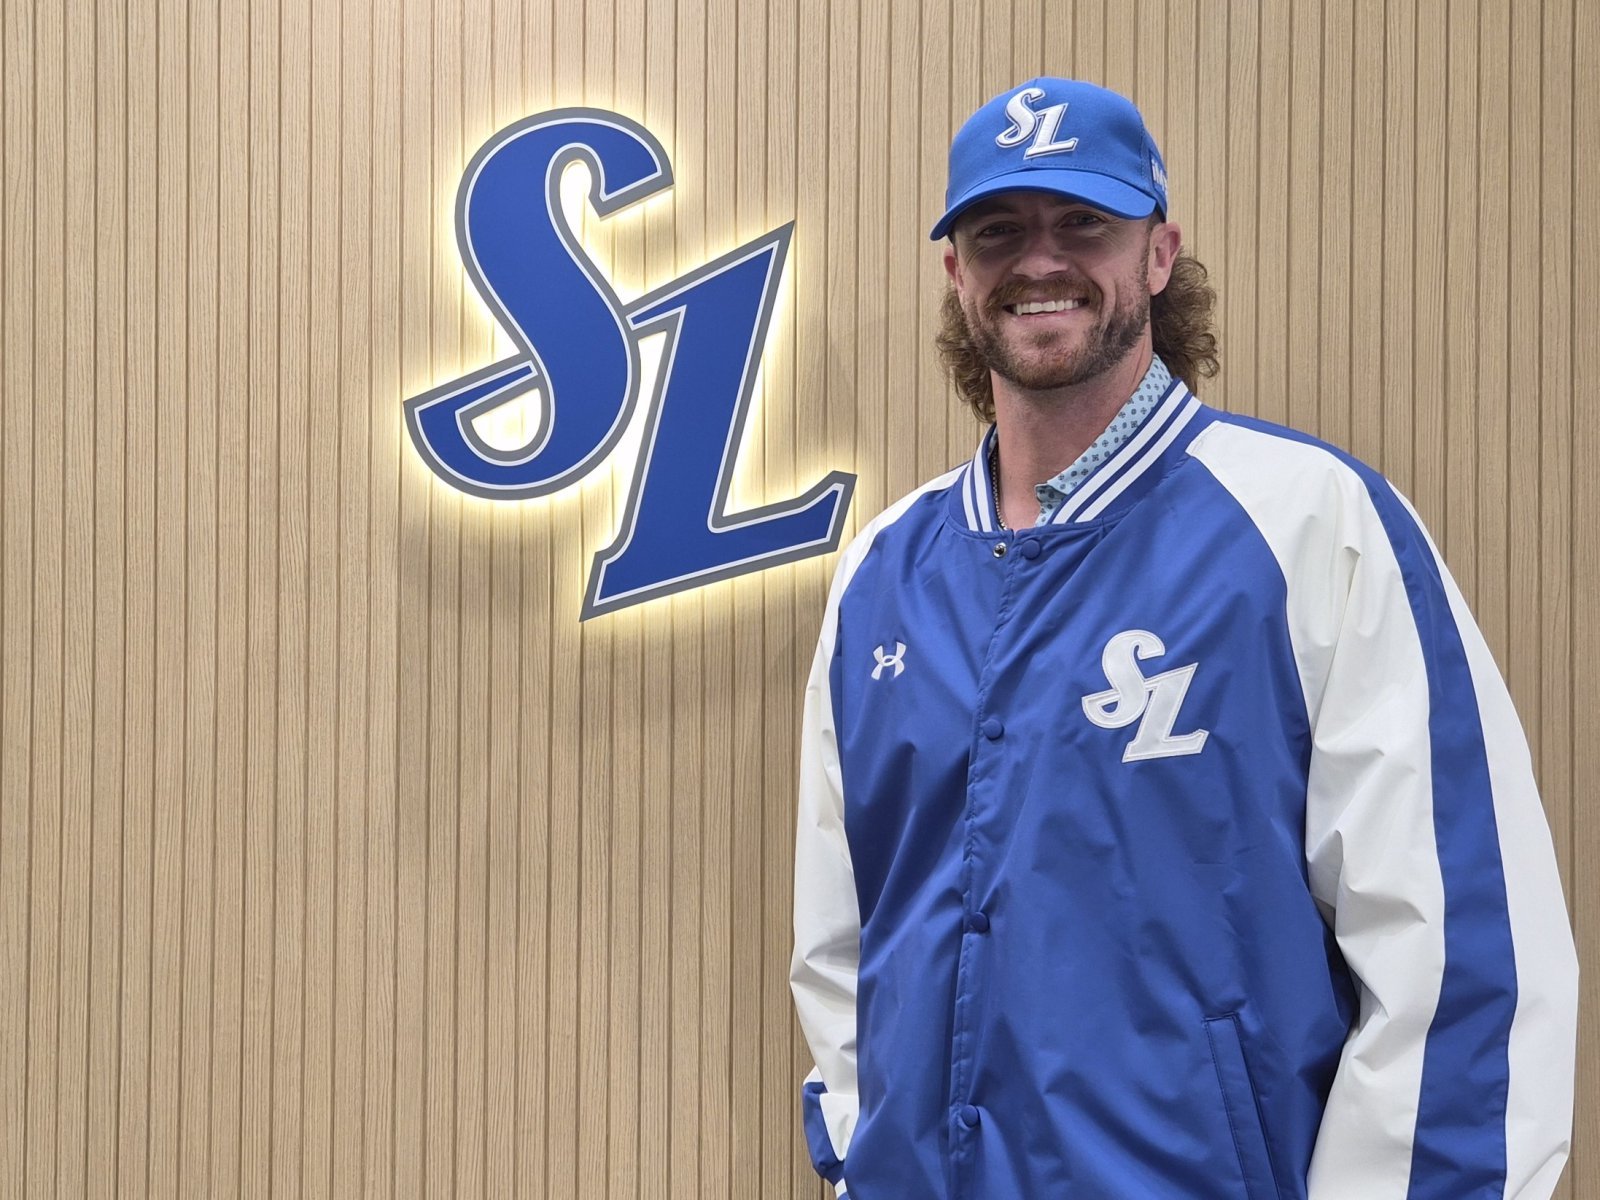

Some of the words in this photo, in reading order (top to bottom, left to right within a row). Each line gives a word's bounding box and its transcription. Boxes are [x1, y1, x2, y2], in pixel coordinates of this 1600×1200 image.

[995, 87, 1079, 160] SL
[403, 107, 857, 622] SL
[1081, 629, 1209, 763] SL
